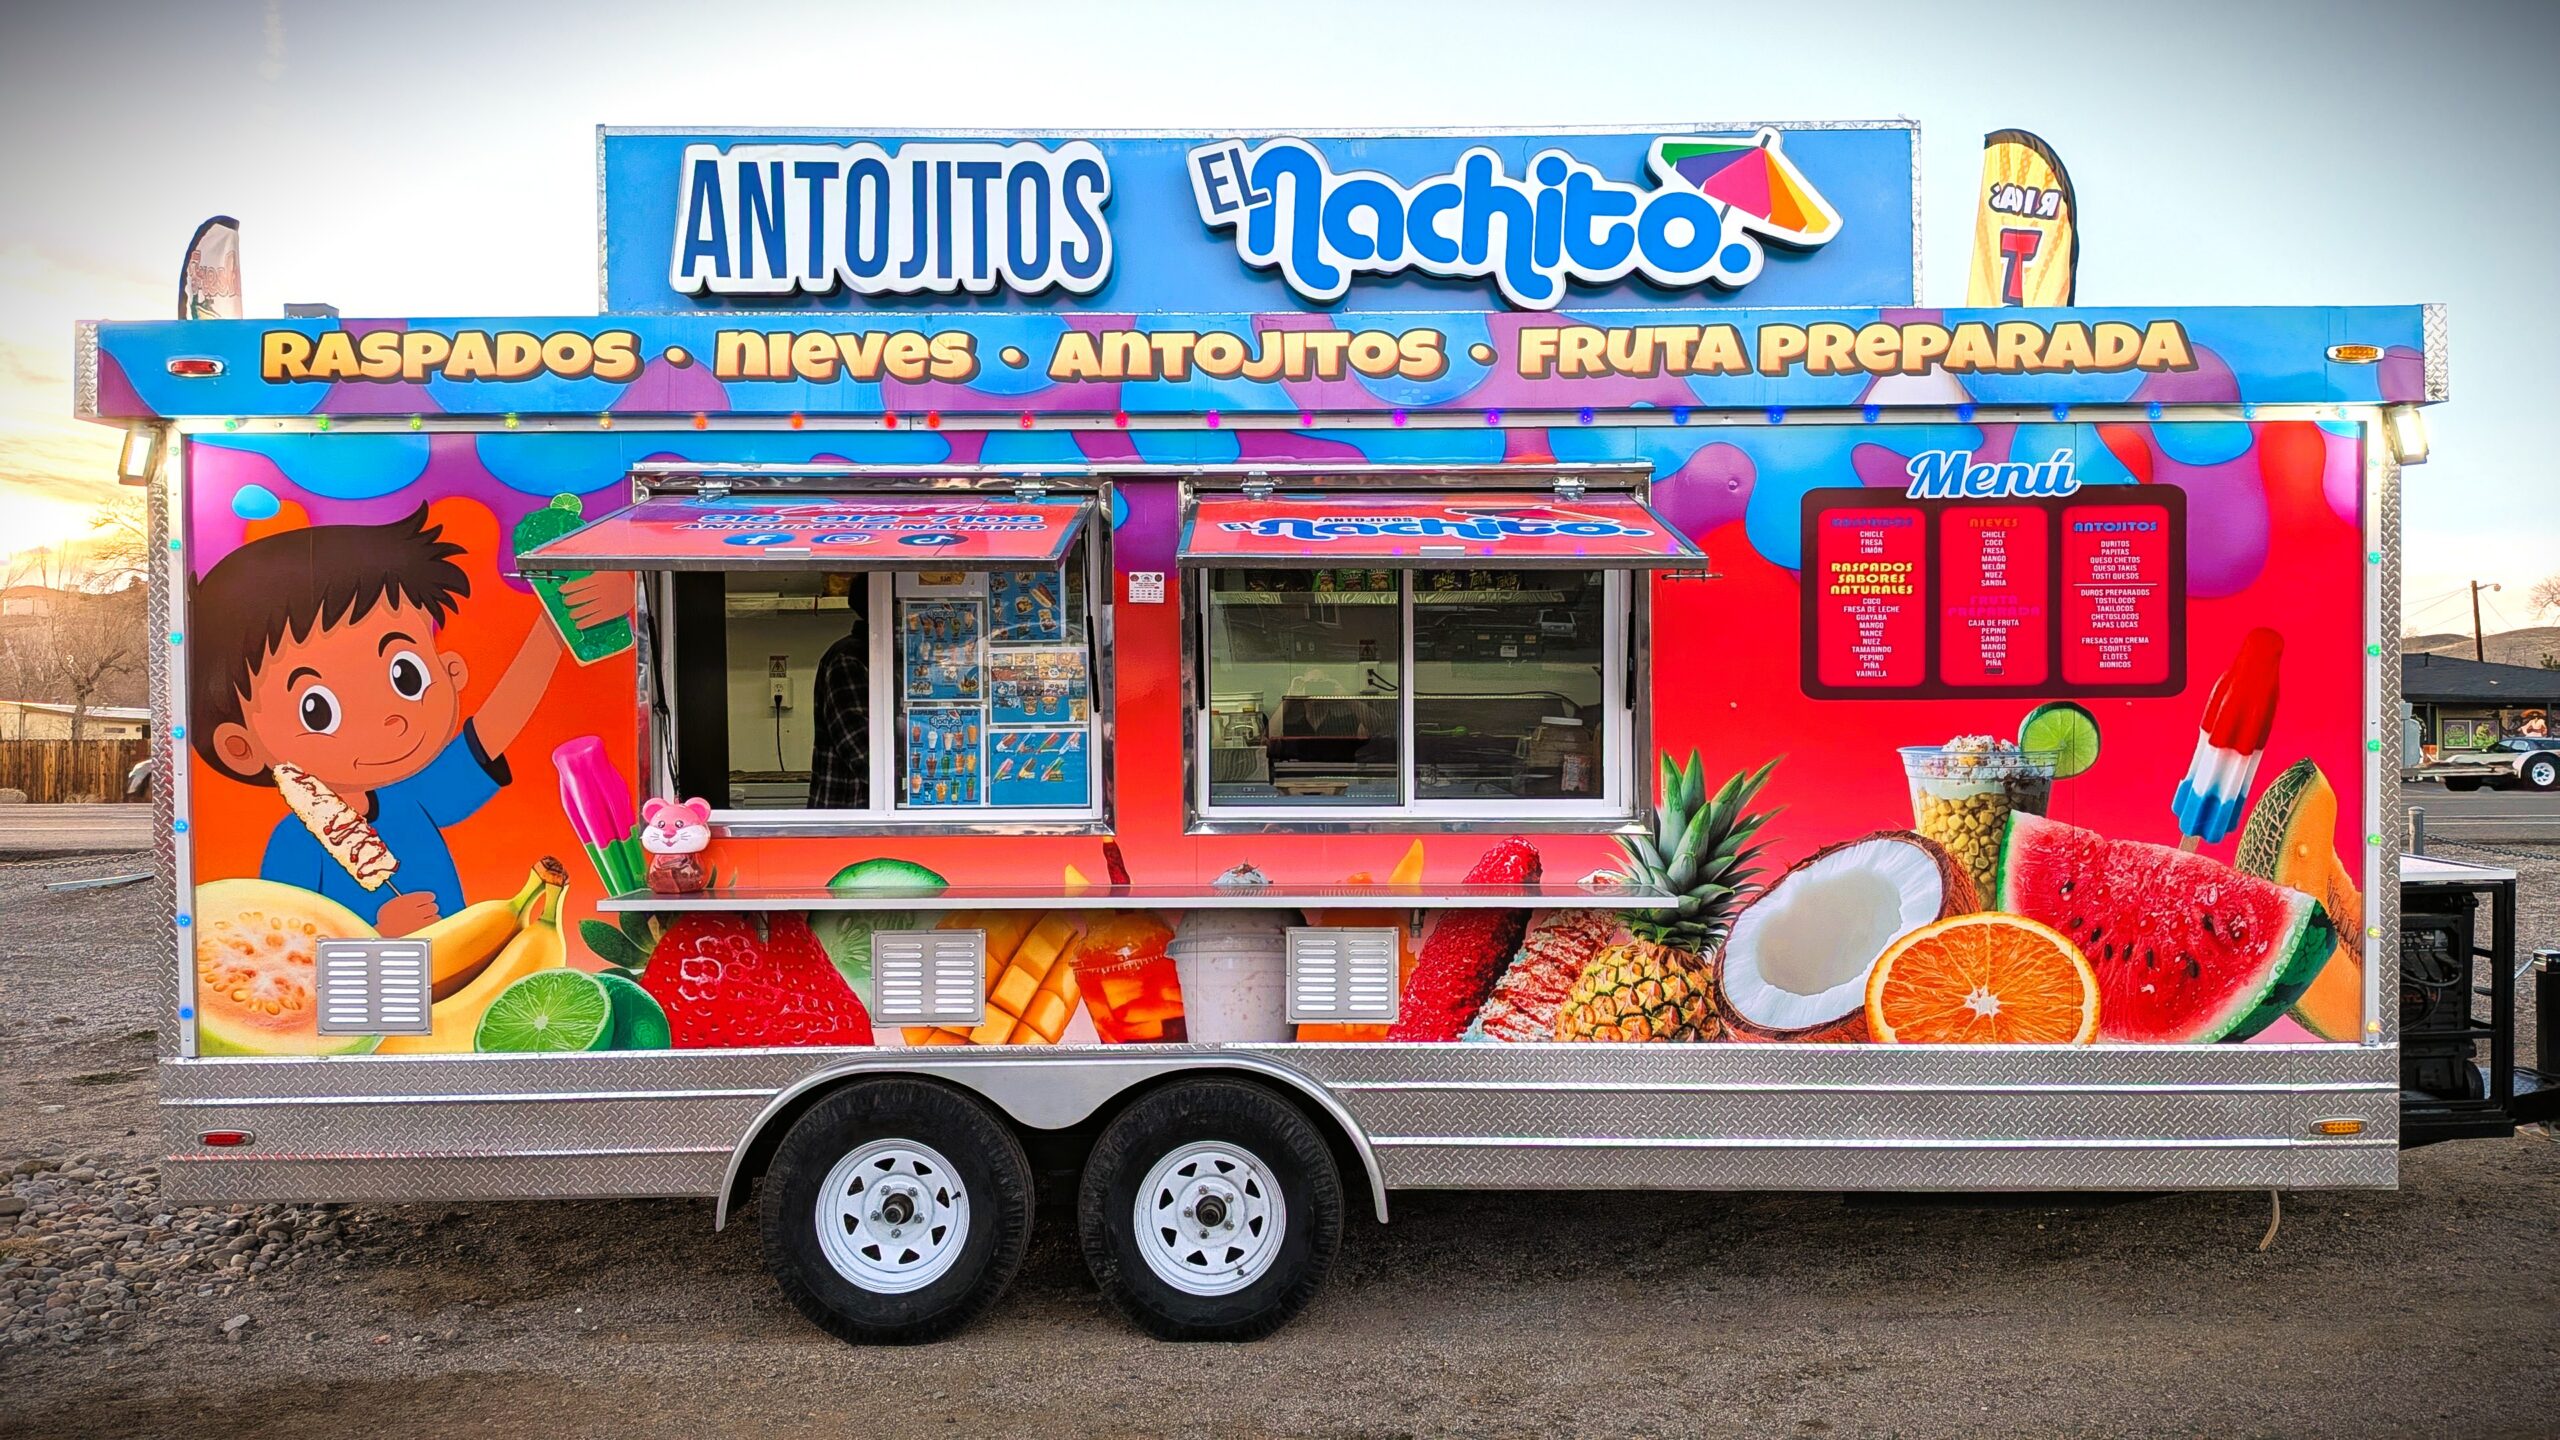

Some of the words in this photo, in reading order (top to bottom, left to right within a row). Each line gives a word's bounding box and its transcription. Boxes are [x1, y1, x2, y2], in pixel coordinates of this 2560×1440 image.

[1198, 148, 1268, 215] EL
[680, 157, 1105, 280] ANTOJITOS
[262, 331, 641, 381] RASPADOS
[1052, 331, 1447, 380] ANTOJITOS
[1518, 324, 1750, 376] FRUTA
[1757, 321, 2196, 374] PREPARADA
[1907, 449, 2080, 497] Menú
[1969, 518, 2018, 528] NIEVES
[2074, 522, 2157, 532] ANTOJITOS
[1831, 563, 1913, 572] RASPADOS
[1838, 574, 1905, 583] SABORES
[1830, 585, 1913, 594] NATURALES
[1863, 661, 1880, 669] PIÑA
